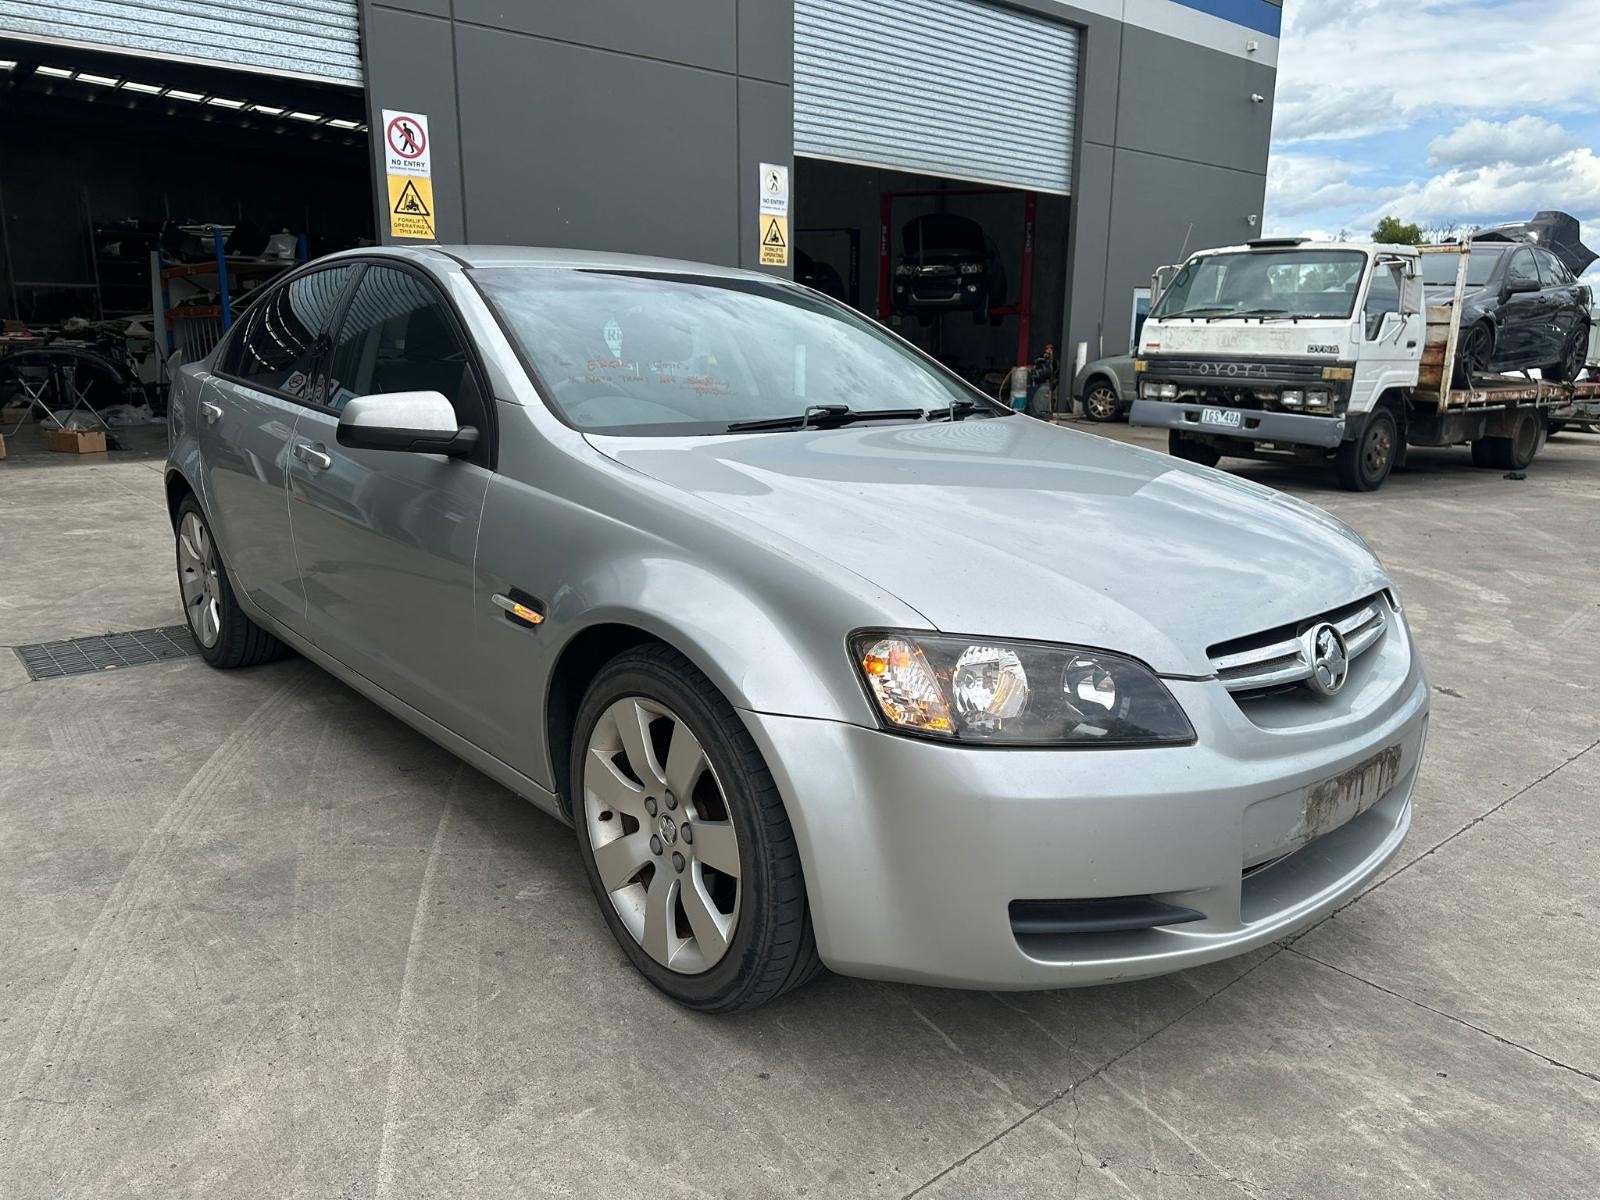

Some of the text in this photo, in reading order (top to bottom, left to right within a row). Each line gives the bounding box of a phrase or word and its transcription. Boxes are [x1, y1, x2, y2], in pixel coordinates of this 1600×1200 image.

[403, 160, 426, 168] ENTRY
[1307, 344, 1340, 353] DYNA
[1186, 362, 1268, 377] TOYOTA
